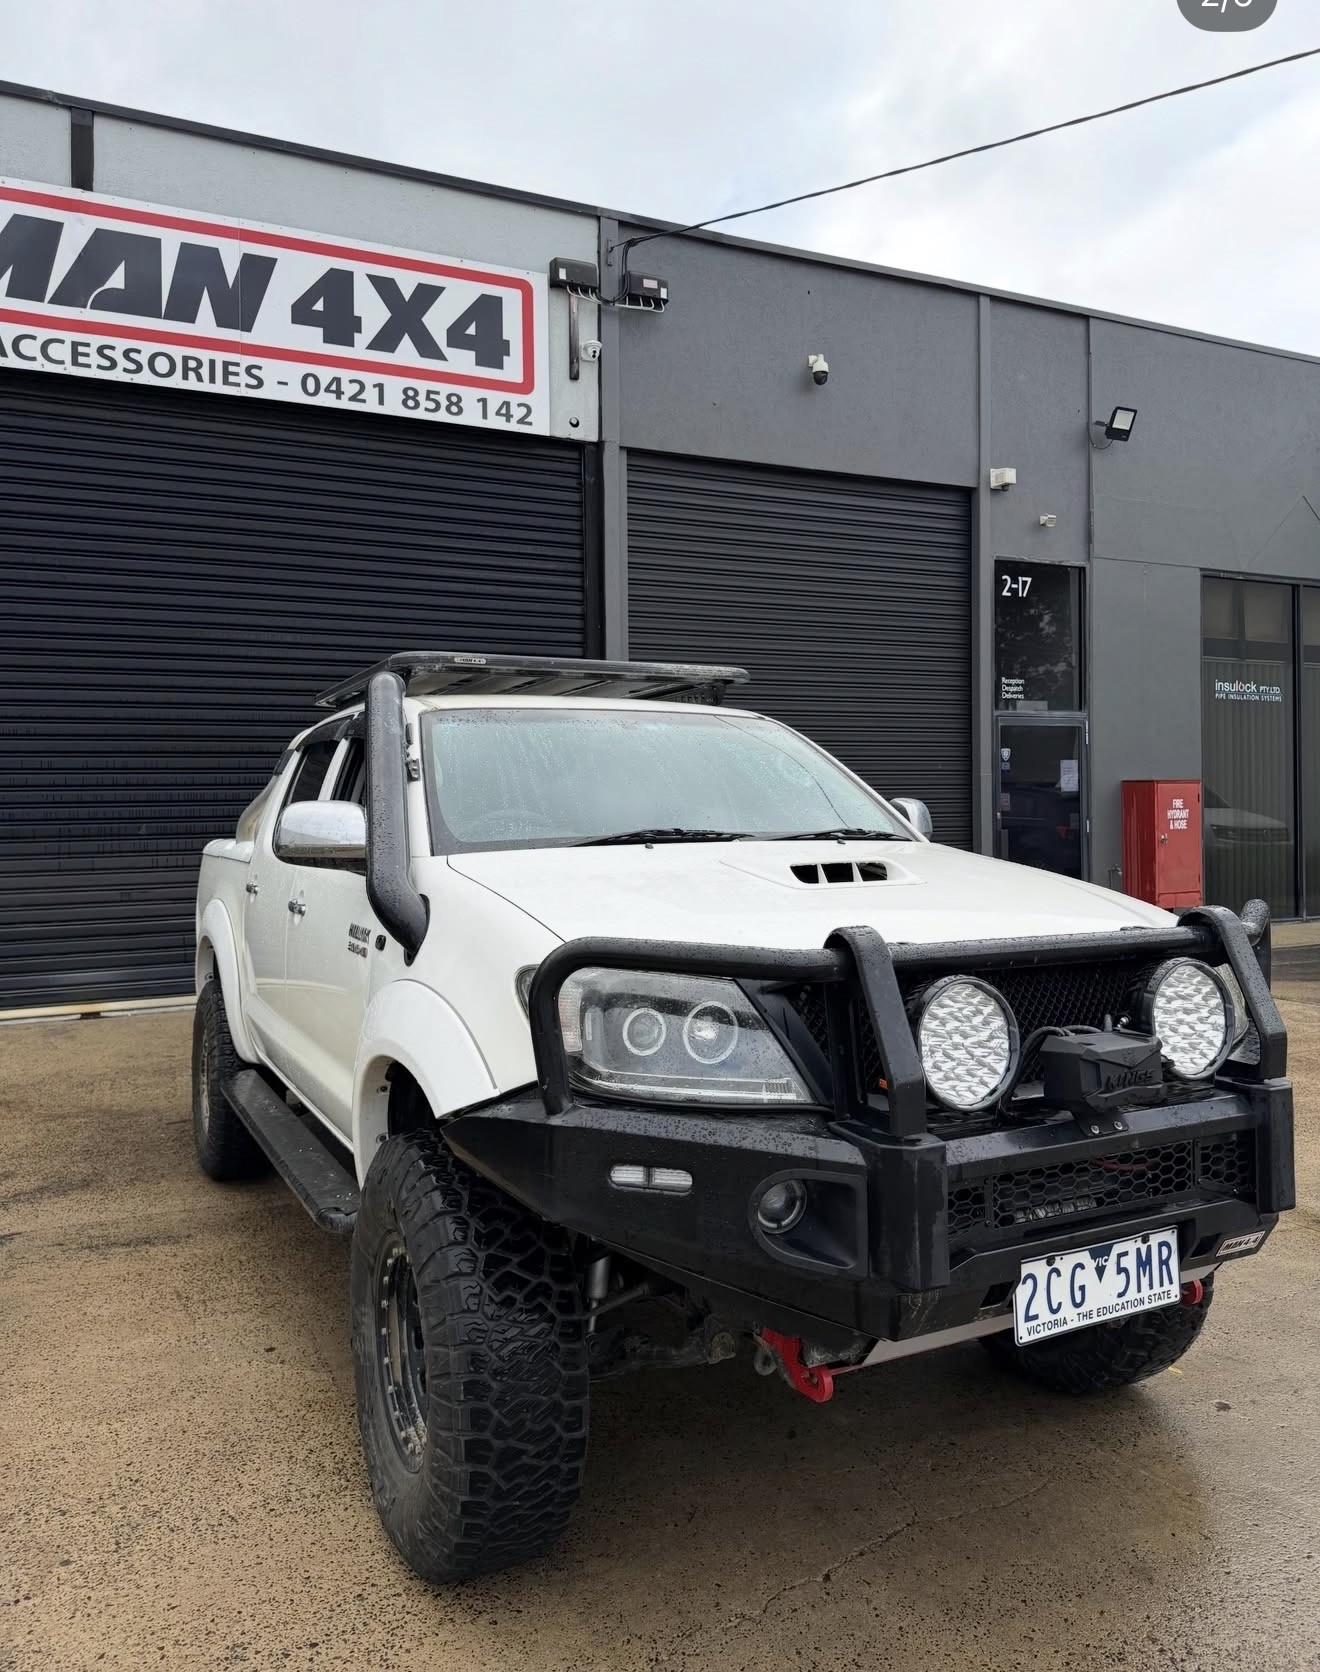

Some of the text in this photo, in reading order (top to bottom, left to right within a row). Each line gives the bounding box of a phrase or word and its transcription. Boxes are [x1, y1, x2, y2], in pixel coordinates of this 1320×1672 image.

[291, 267, 510, 370] 4X4
[301, 372, 385, 406] 0421
[401, 386, 464, 417] 858
[476, 397, 533, 426] 142
[1001, 574, 1033, 598] 2-17
[1001, 676, 1025, 685] Reception
[1215, 679, 1257, 693] insulock
[1001, 684, 1024, 692] Despatch
[1001, 692, 1025, 700] Deliveries
[1227, 693, 1260, 701] INSULATION
[1172, 798, 1184, 809] FIRE
[1167, 809, 1189, 819] HYDRANT
[1169, 819, 1188, 830] & HOSE
[1092, 1255, 1109, 1266] VIC
[1021, 1240, 1174, 1323] 2CG 5MR
[1026, 1316, 1068, 1337] VICTORIA
[1076, 1310, 1094, 1323] THE
[1096, 1296, 1145, 1318] EDUCATION
[1147, 1289, 1172, 1304] STATE
